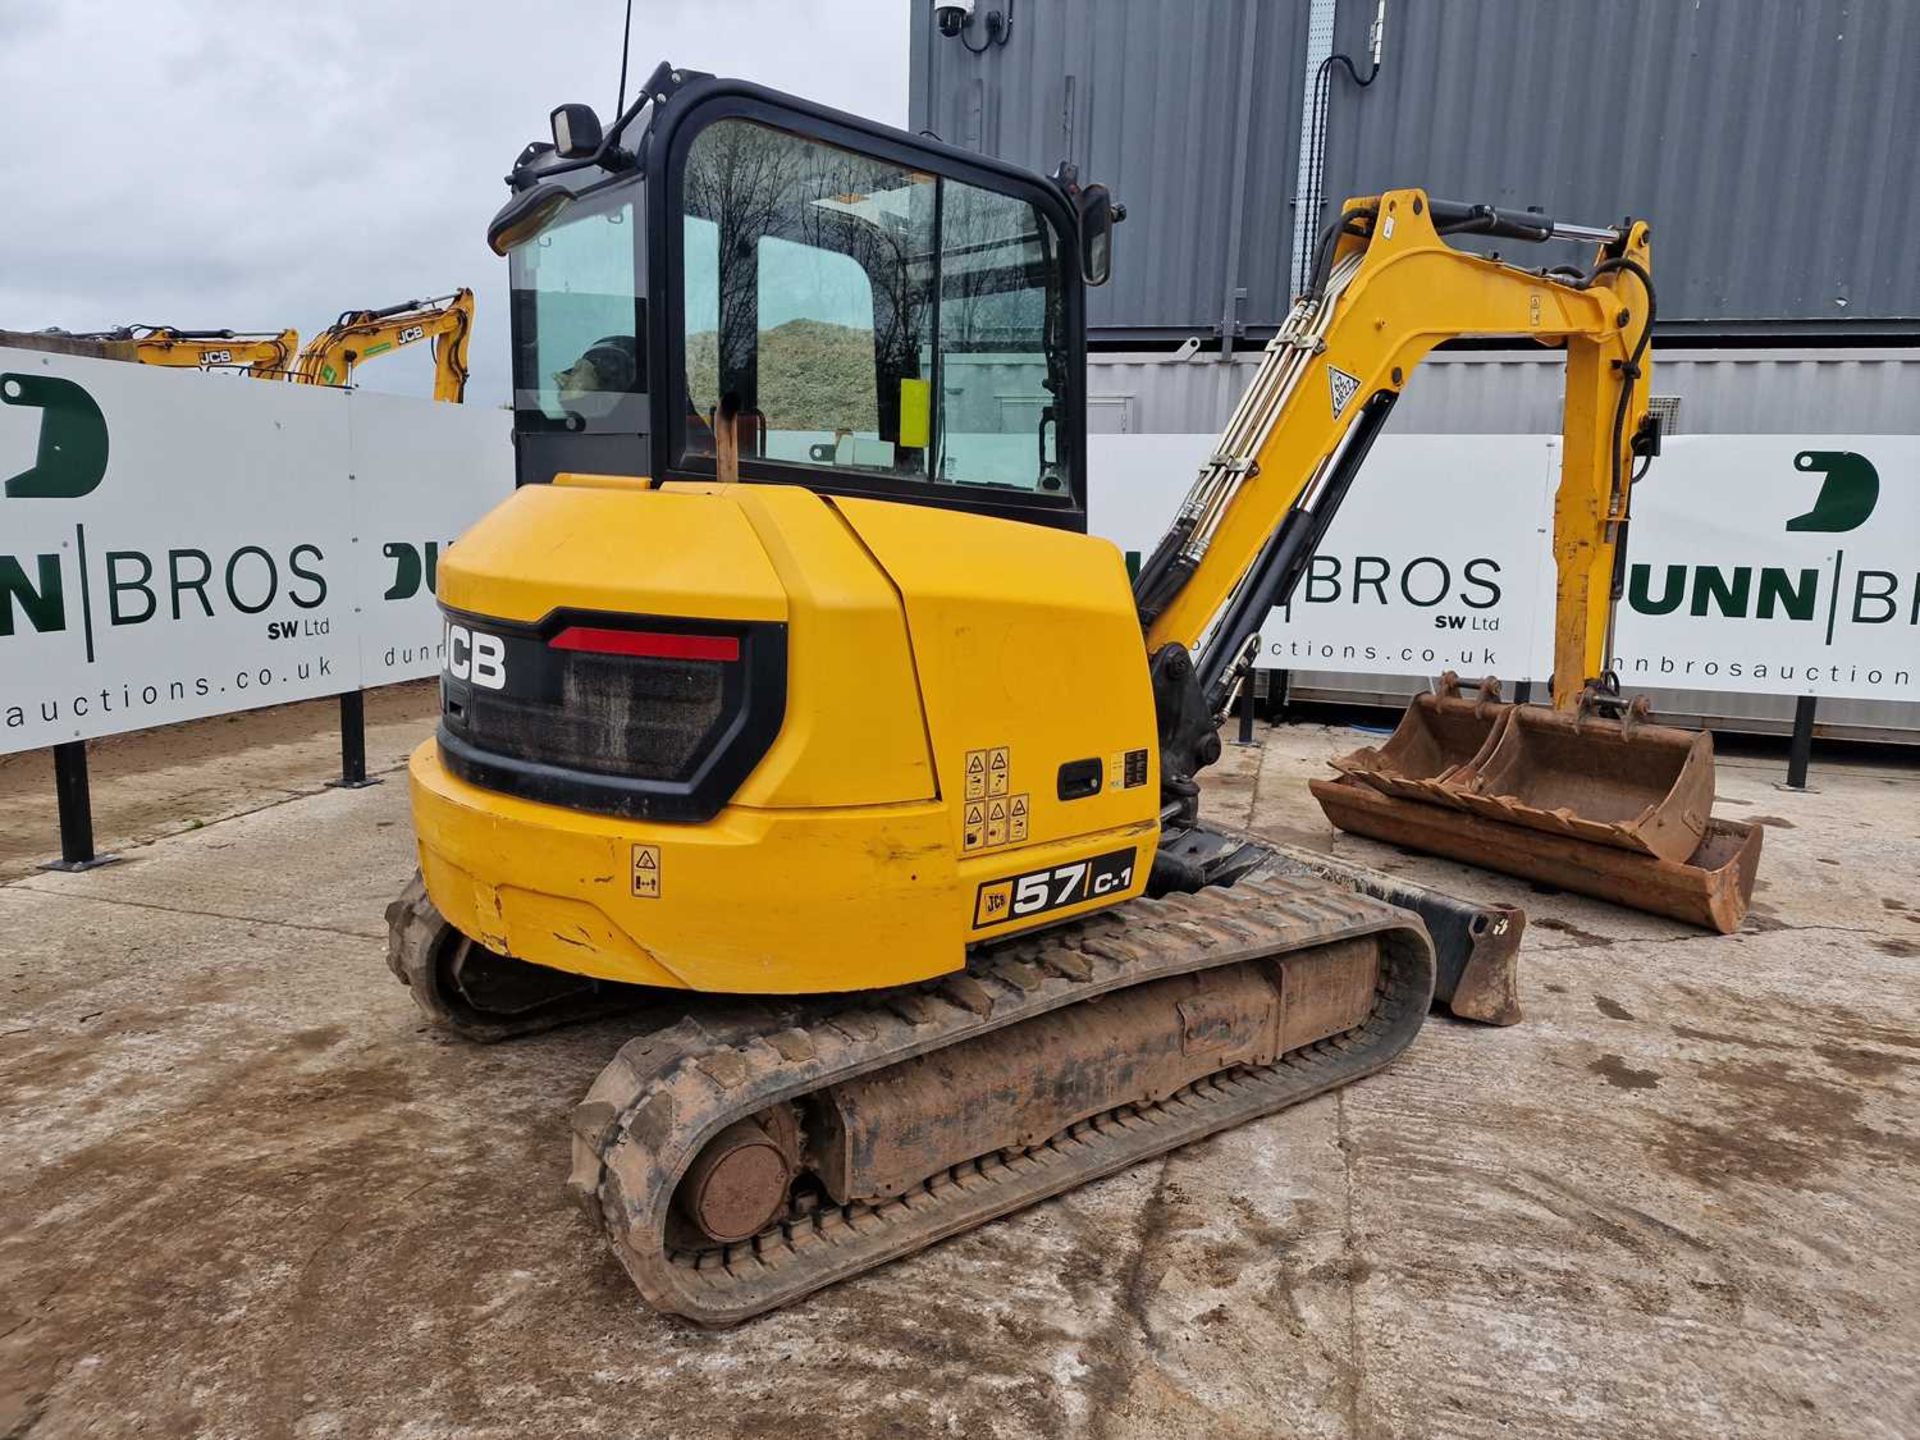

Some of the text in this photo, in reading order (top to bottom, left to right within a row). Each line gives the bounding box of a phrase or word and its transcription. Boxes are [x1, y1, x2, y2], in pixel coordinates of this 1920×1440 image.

[398, 326, 424, 344] JCB
[200, 350, 232, 364] JCB
[106, 544, 328, 626] BROS
[1304, 555, 1501, 609] BROS
[267, 617, 330, 640] SW Ltd
[1434, 615, 1500, 632] SW Ltd
[1013, 862, 1086, 915] 57
[1094, 866, 1132, 894] C-1
